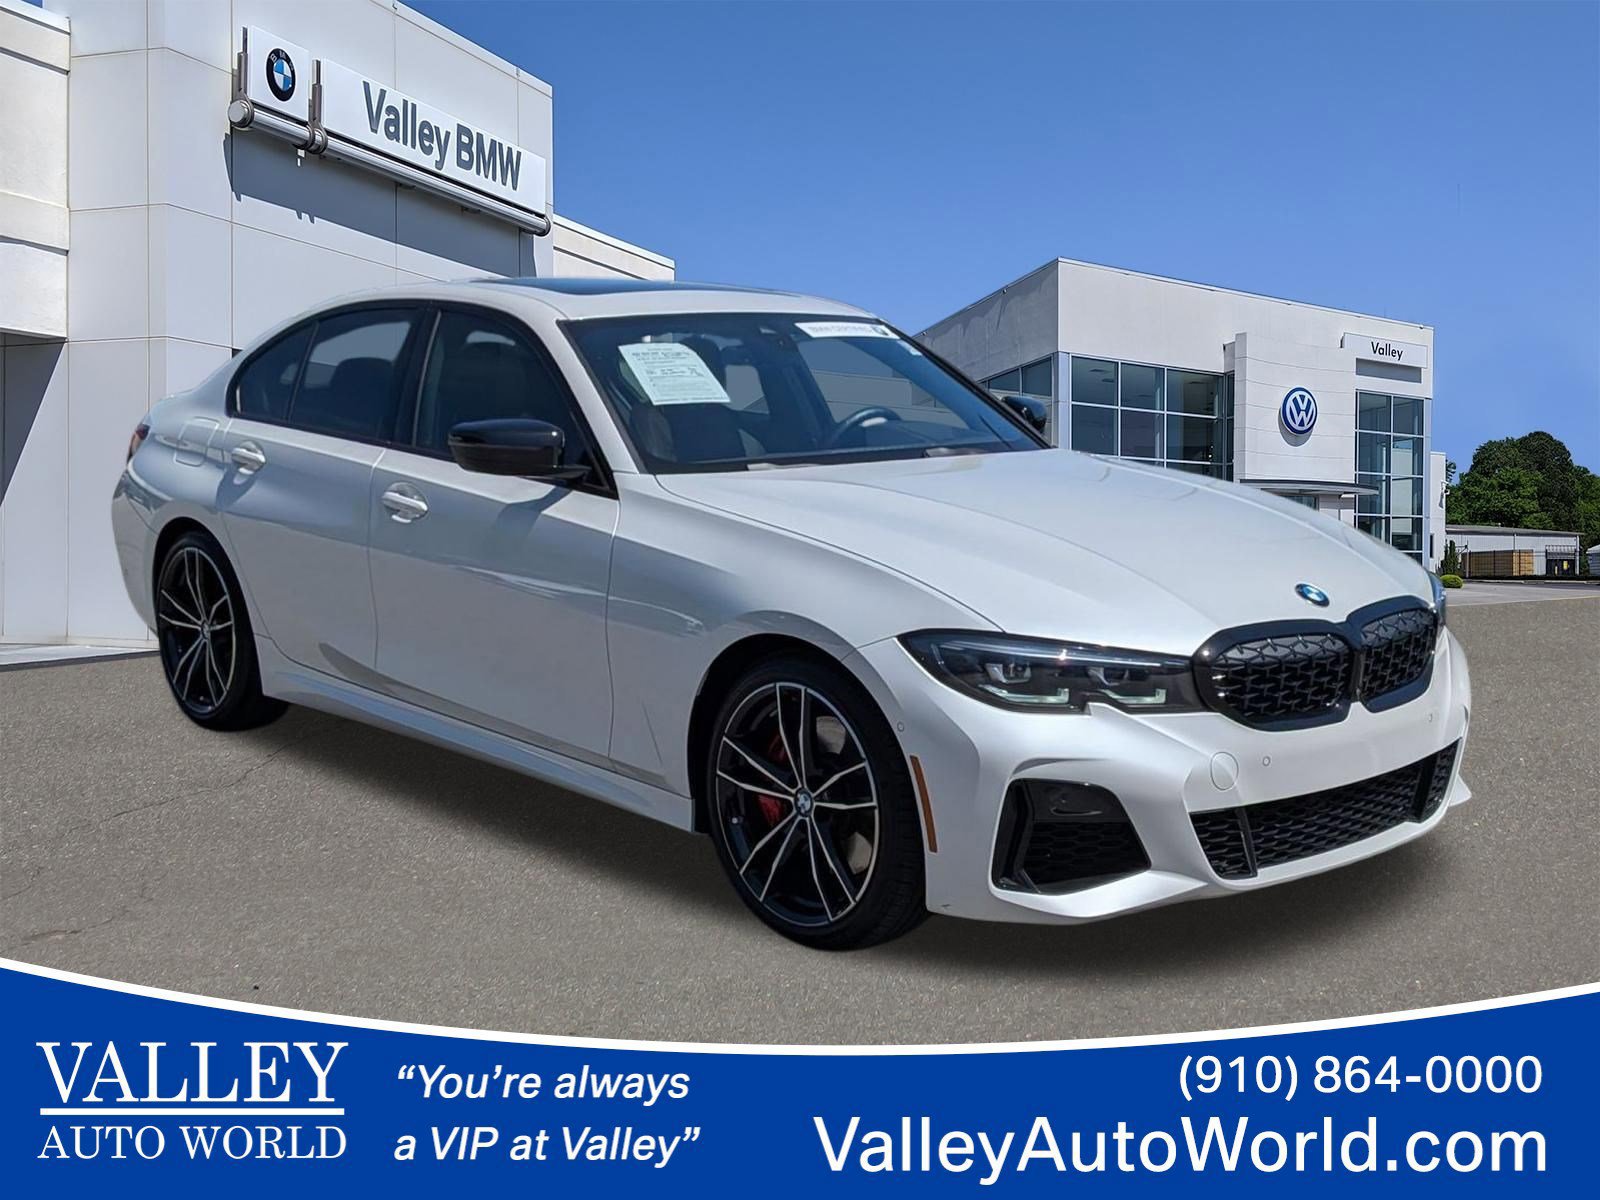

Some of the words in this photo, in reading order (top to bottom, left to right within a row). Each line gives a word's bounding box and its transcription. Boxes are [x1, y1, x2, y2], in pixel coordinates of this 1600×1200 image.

[363, 81, 451, 170] Valley
[456, 123, 522, 191] BMW
[1371, 342, 1403, 361] Valley
